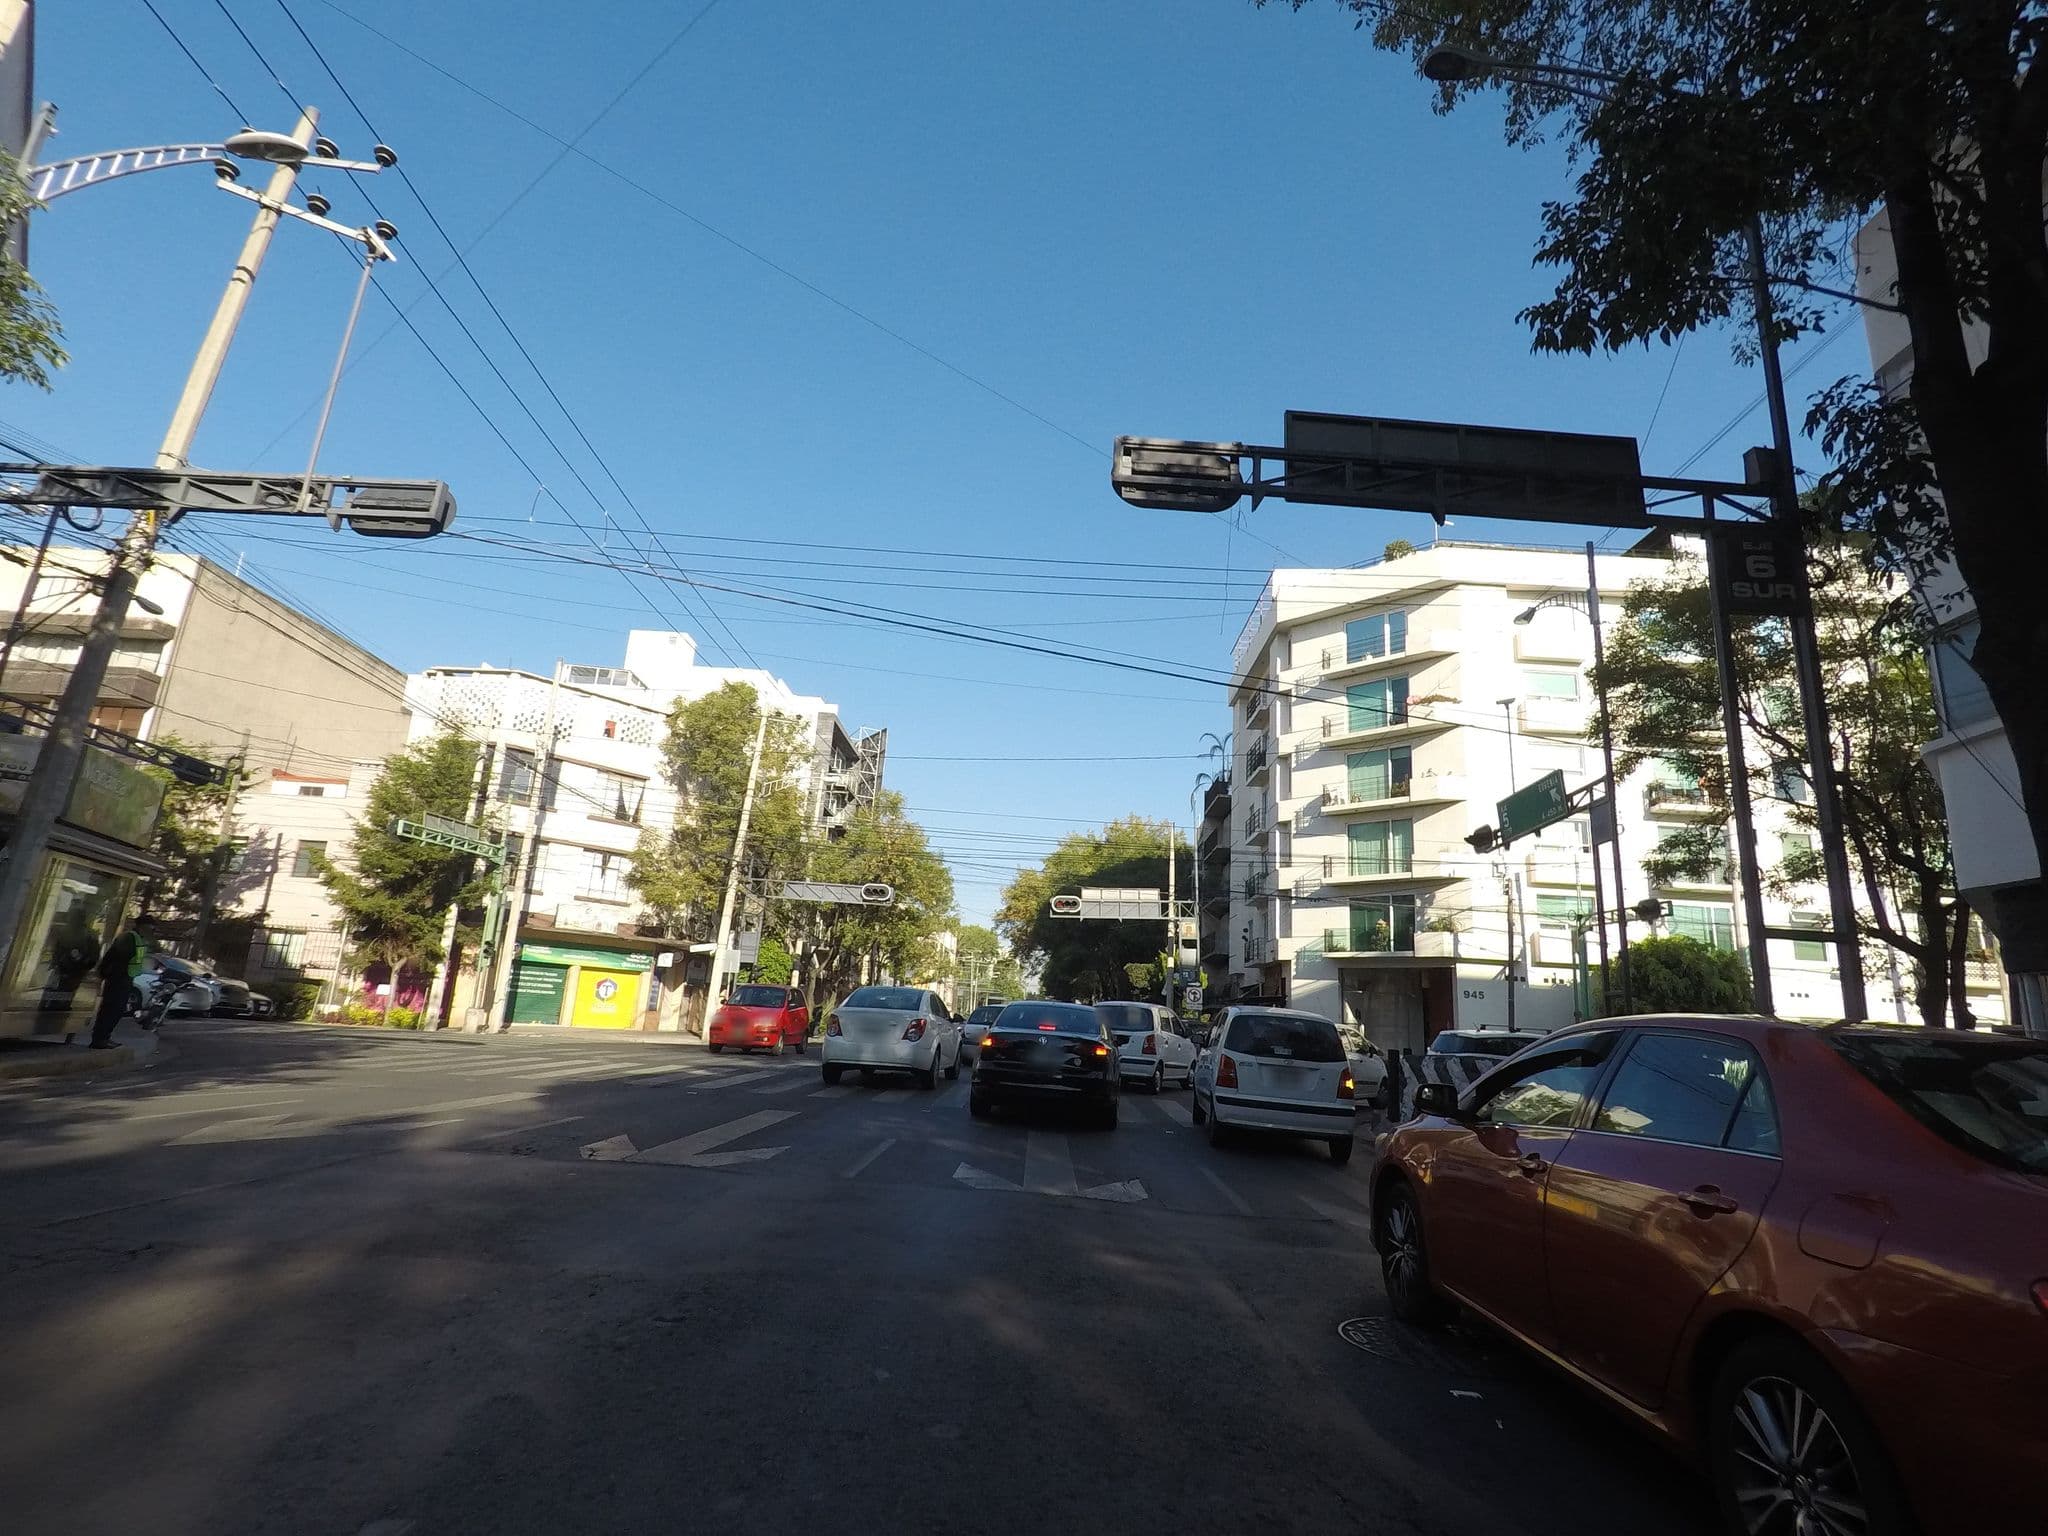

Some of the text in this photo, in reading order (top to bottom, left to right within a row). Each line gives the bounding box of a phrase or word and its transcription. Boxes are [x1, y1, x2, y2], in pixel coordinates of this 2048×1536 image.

[1745, 555, 1777, 578] 6
[1731, 582, 1797, 600] SUR
[1502, 812, 1510, 828] 5
[1463, 990, 1485, 1000] 945
